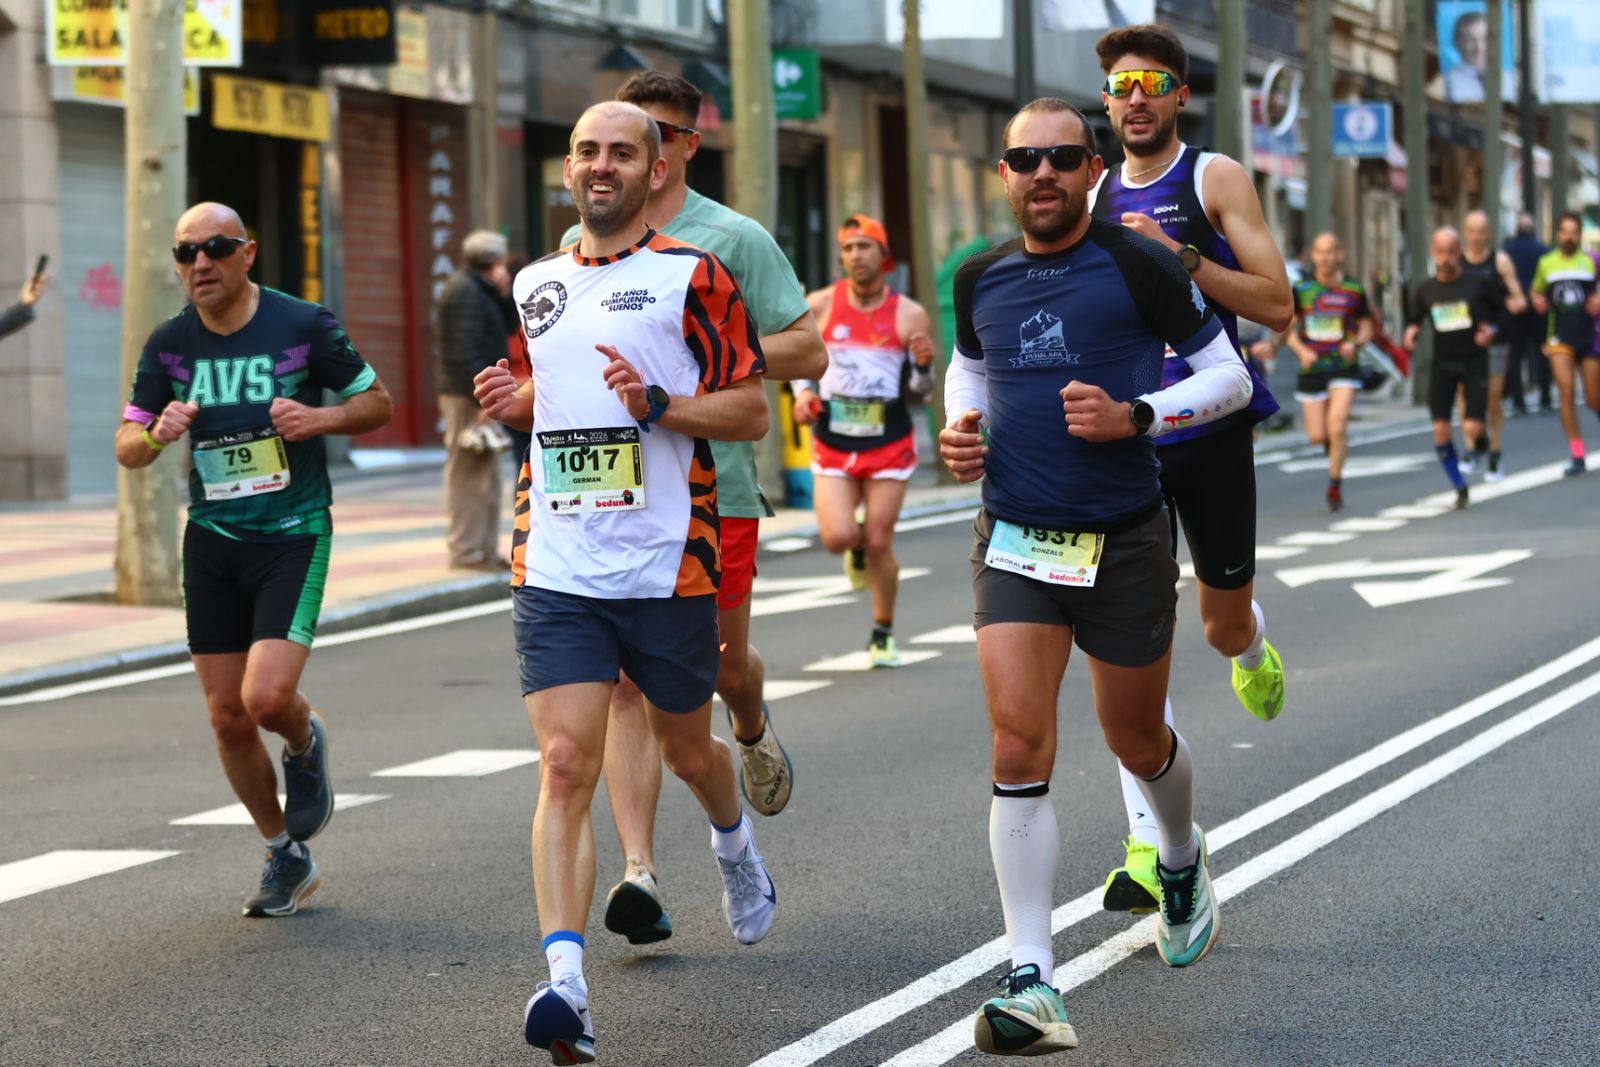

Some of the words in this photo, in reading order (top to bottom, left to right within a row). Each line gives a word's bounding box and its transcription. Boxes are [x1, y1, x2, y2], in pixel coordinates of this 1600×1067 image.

[57, 29, 221, 50] SALACA
[600, 296, 656, 307] CUMPLIENDO
[612, 291, 621, 299] 10
[622, 288, 648, 297] AÑOS
[190, 355, 275, 408] AVS
[589, 431, 608, 440] 2026
[223, 447, 252, 467] 79
[556, 449, 620, 473] 1017
[594, 499, 634, 509] bedun
[1022, 526, 1080, 547] 1937
[1031, 546, 1064, 557] GONZALO
[991, 555, 1020, 567] LABORAL
[1048, 572, 1085, 583] bedunia
[764, 766, 785, 805] CRAFT
